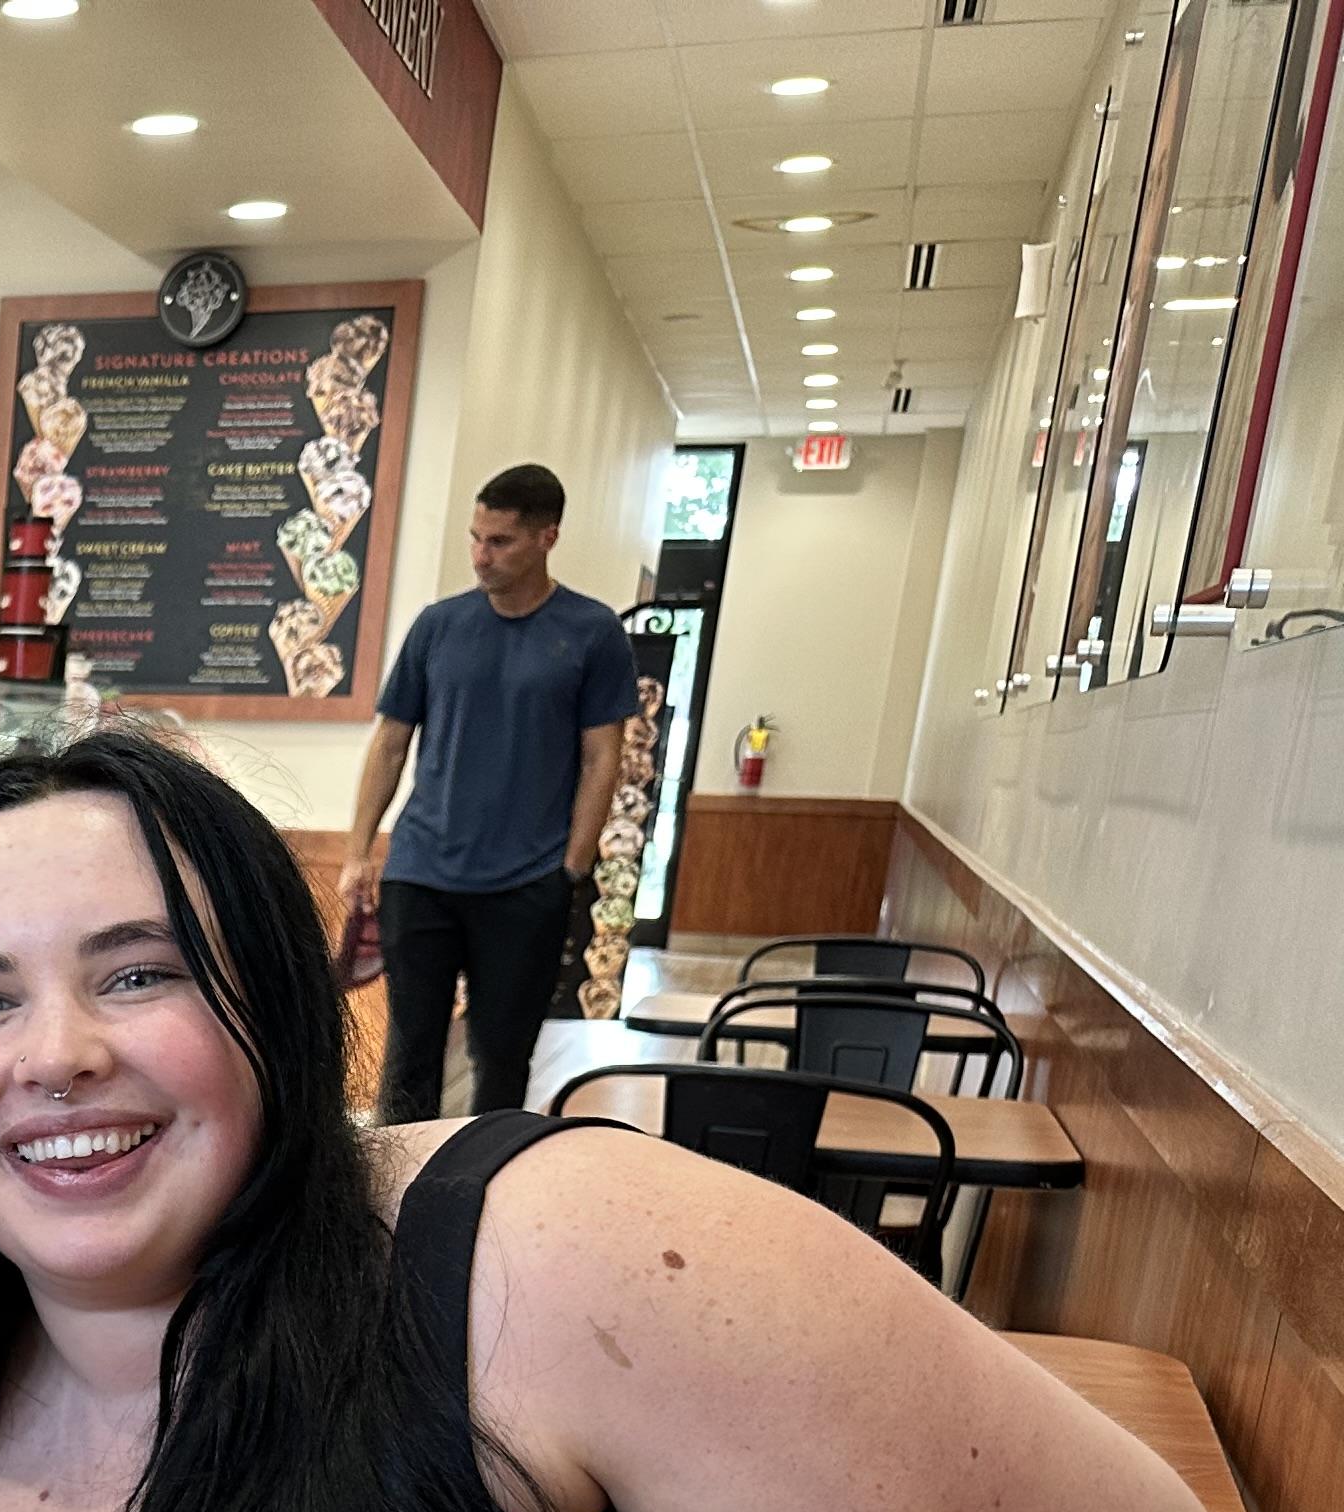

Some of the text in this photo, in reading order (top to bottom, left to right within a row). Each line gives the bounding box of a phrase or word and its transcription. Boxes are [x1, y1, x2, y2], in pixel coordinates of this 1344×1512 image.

[94, 348, 311, 371] SIGNATURE CREATIONS
[136, 374, 191, 388] VANILLA
[218, 371, 302, 386] CHOCOLATE
[802, 433, 846, 465] EXIT
[85, 465, 170, 479] STRAWBERRY
[207, 462, 296, 477] CAKE BATTER
[226, 541, 261, 552] MINT
[209, 623, 261, 638] COFFEE
